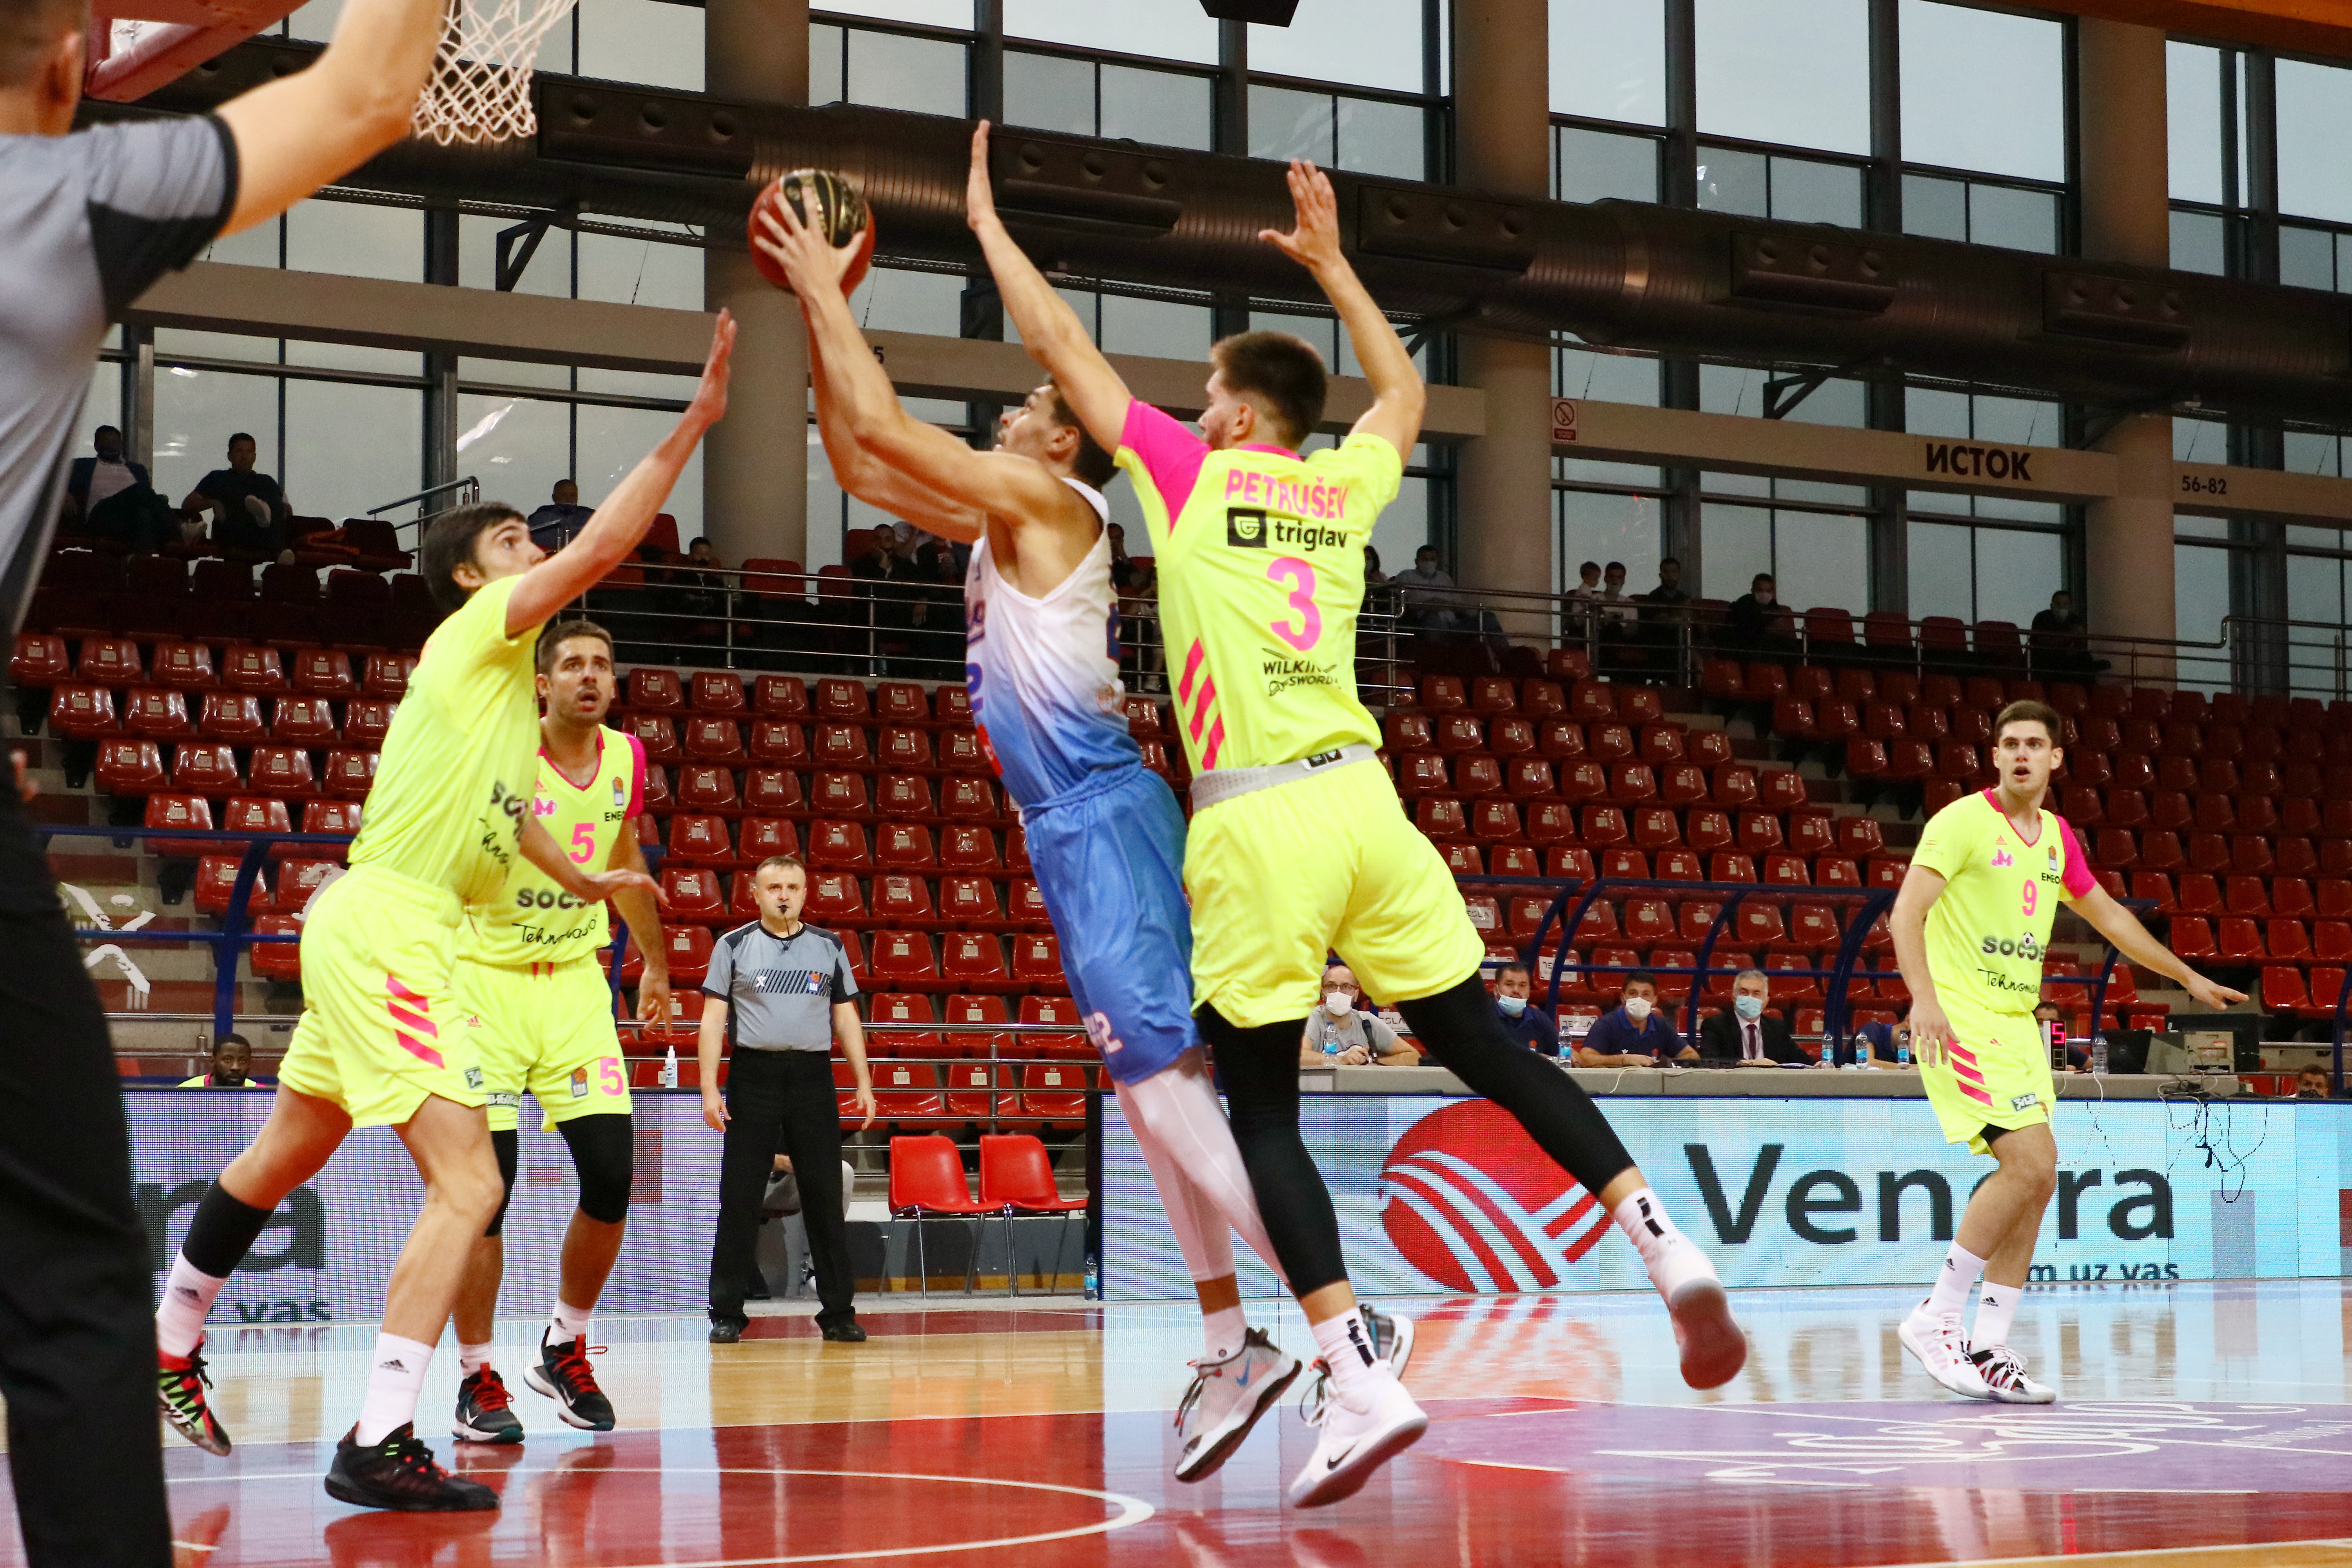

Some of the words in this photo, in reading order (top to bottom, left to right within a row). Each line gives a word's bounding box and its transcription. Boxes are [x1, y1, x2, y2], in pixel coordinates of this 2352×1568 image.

[1926, 443, 2031, 481] ИСТОК
[2181, 475, 2227, 495] 56-82
[1275, 519, 1347, 551] triglav
[1266, 556, 1322, 652] 3
[569, 822, 595, 864] 5
[2022, 879, 2037, 916] 9
[2050, 1023, 2065, 1044] 5
[599, 1057, 624, 1096] 5
[1683, 1144, 2174, 1244] Venra
[2070, 1264, 2108, 1280] uz
[2120, 1263, 2179, 1280] vas
